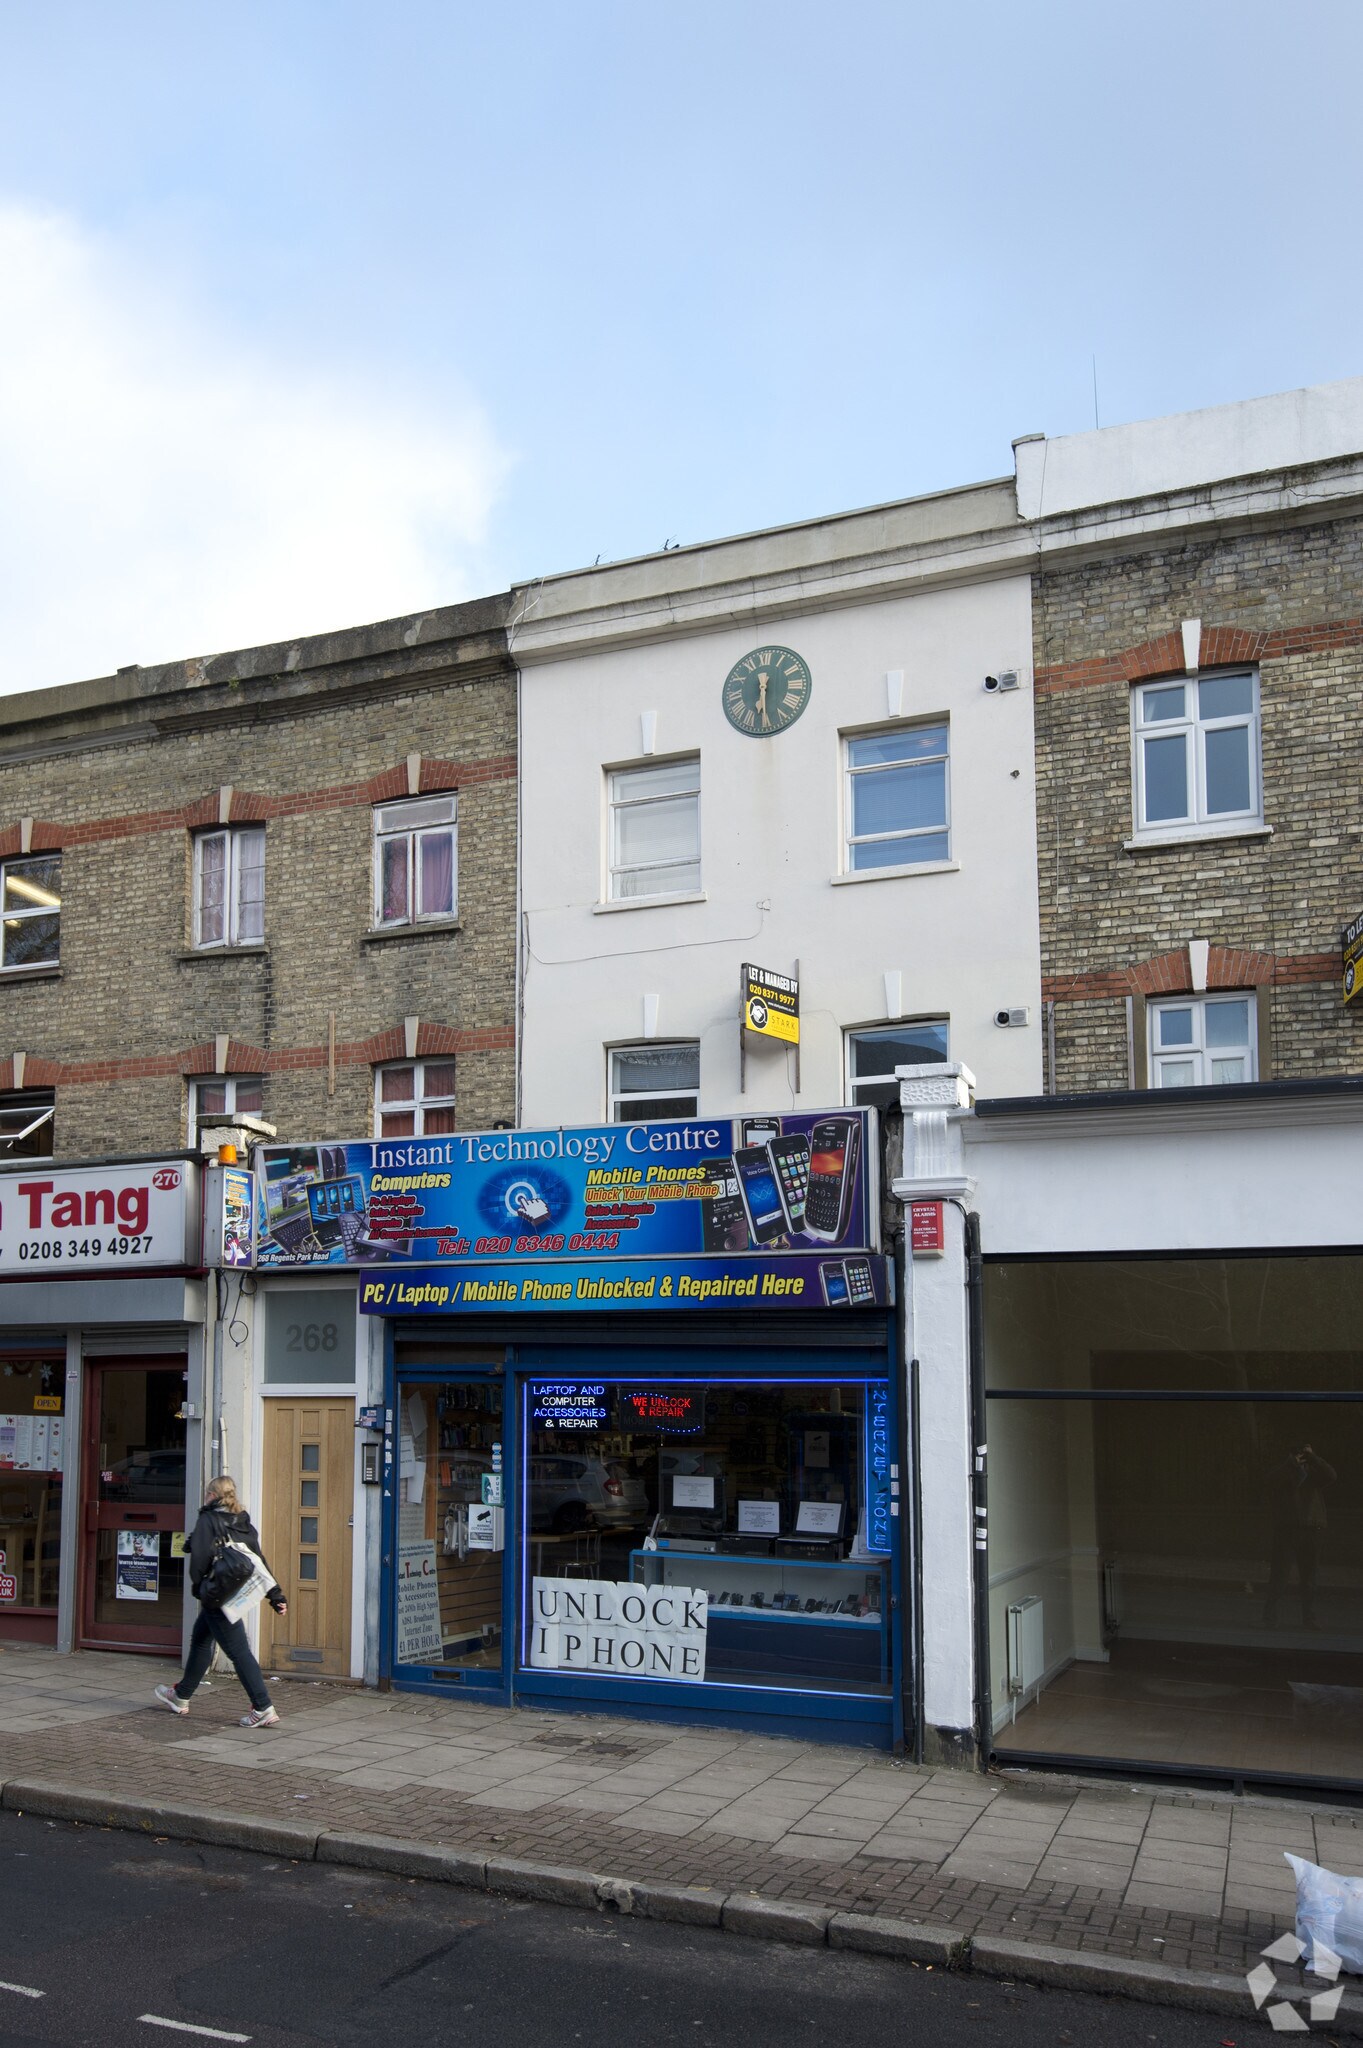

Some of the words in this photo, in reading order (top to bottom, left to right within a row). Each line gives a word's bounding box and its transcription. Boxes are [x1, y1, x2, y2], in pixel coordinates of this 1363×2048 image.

[1347, 926, 1355, 944] TO
[748, 966, 758, 981] LET
[760, 970, 764, 983] &
[765, 972, 790, 992] MANAGED
[790, 980, 798, 993] BY
[749, 984, 762, 996] 020
[762, 988, 778, 1000] 8371
[779, 994, 795, 1006] 9977
[370, 1142, 454, 1169] Instant
[461, 1131, 616, 1163] Technology
[626, 1126, 720, 1152] Centre
[154, 1172, 180, 1186] 270
[586, 1168, 642, 1186] Mobile
[646, 1164, 706, 1183] Phones
[370, 1172, 452, 1193] Computers
[586, 1187, 622, 1202] Unlock
[623, 1186, 646, 1200] Your
[648, 1184, 683, 1200] Mobile
[685, 1182, 720, 1198] Phone
[388, 1194, 416, 1206] Laptops
[18, 1181, 149, 1236] Tang
[398, 1206, 424, 1219] Repairs
[584, 1205, 610, 1216] Sales
[611, 1204, 619, 1215] &
[620, 1202, 655, 1218] Repairs
[584, 1216, 640, 1230] Accessories
[368, 1230, 380, 1240] All
[414, 1226, 458, 1238] Accessories
[19, 1240, 62, 1260] 0208
[68, 1239, 101, 1257] 349
[108, 1236, 153, 1255] 4927
[436, 1238, 470, 1256] Tel:
[474, 1236, 512, 1254] 020
[516, 1234, 564, 1252] 8346
[568, 1232, 619, 1250] 0444
[258, 1254, 269, 1262] 268
[270, 1252, 295, 1264] Regents
[296, 1252, 309, 1262] Park
[310, 1252, 329, 1261] Road
[364, 1284, 384, 1303] PC
[386, 1283, 397, 1302] /
[398, 1281, 449, 1306] Laptop
[452, 1281, 462, 1302] /
[463, 1280, 518, 1301] Mobile
[522, 1278, 571, 1300] Phone
[576, 1276, 654, 1299] Unlocked
[660, 1276, 673, 1297] &
[678, 1274, 762, 1300] Repaired
[764, 1274, 804, 1295] Here
[286, 1323, 338, 1352] 268
[533, 1386, 576, 1395] LAPTOP
[580, 1385, 605, 1394] AND
[37, 1399, 58, 1407] OPEN
[542, 1396, 595, 1406] COMPUTER
[632, 1397, 647, 1407] WE
[651, 1397, 691, 1408] UNLOCK
[534, 1408, 606, 1418] ACCESSORIES
[638, 1407, 645, 1416] &
[650, 1407, 684, 1417] REPAIR
[545, 1419, 554, 1428] &
[559, 1419, 598, 1428] REPAIR
[416, 1581, 436, 1590] Phones
[404, 1590, 436, 1602] Accessories
[537, 1590, 706, 1629] UNLOCK
[404, 1626, 421, 1637] Internet
[422, 1624, 432, 1633] Zone
[408, 1638, 420, 1651] PER
[421, 1634, 440, 1648] HOUR
